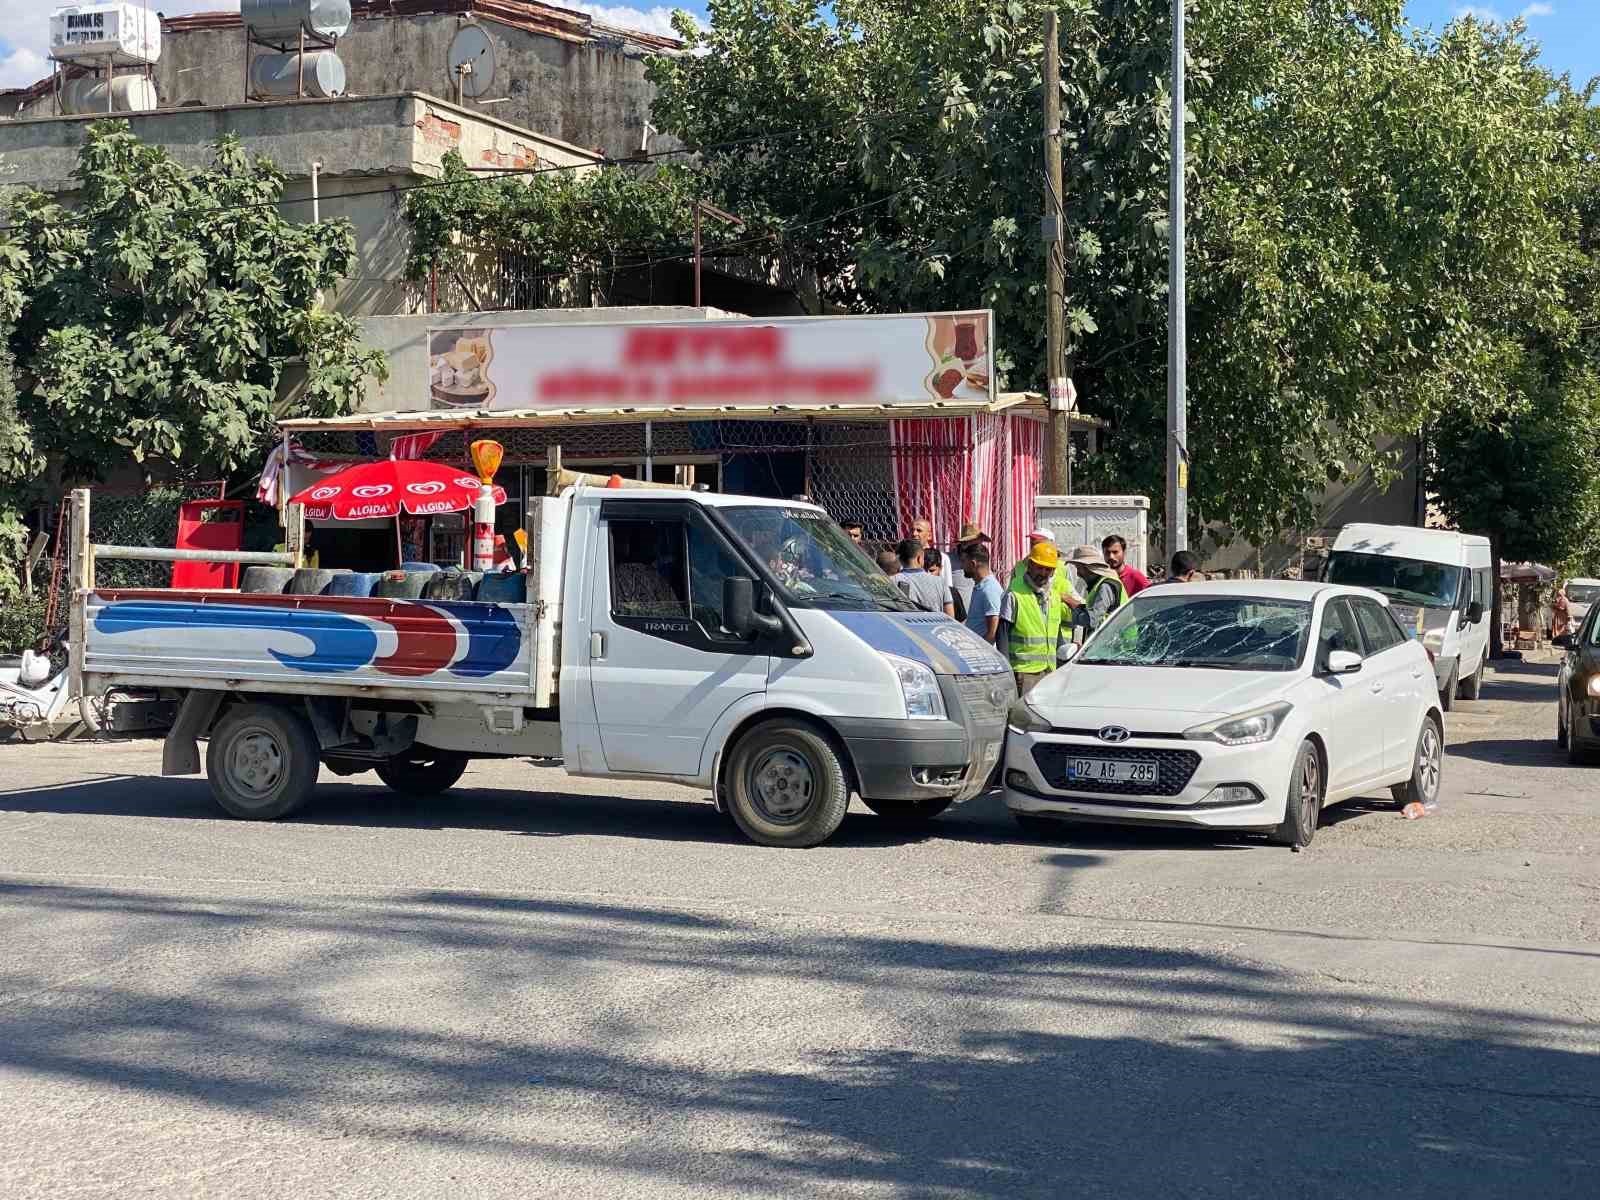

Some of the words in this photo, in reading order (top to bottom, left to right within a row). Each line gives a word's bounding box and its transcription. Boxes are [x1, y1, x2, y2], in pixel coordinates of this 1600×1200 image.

[305, 507, 325, 517] LGIDA
[348, 504, 388, 516] ALGIDA
[415, 501, 454, 512] ALGIDA
[1076, 760, 1092, 777] 02
[1100, 762, 1116, 778] AG
[1130, 764, 1154, 780] 285
